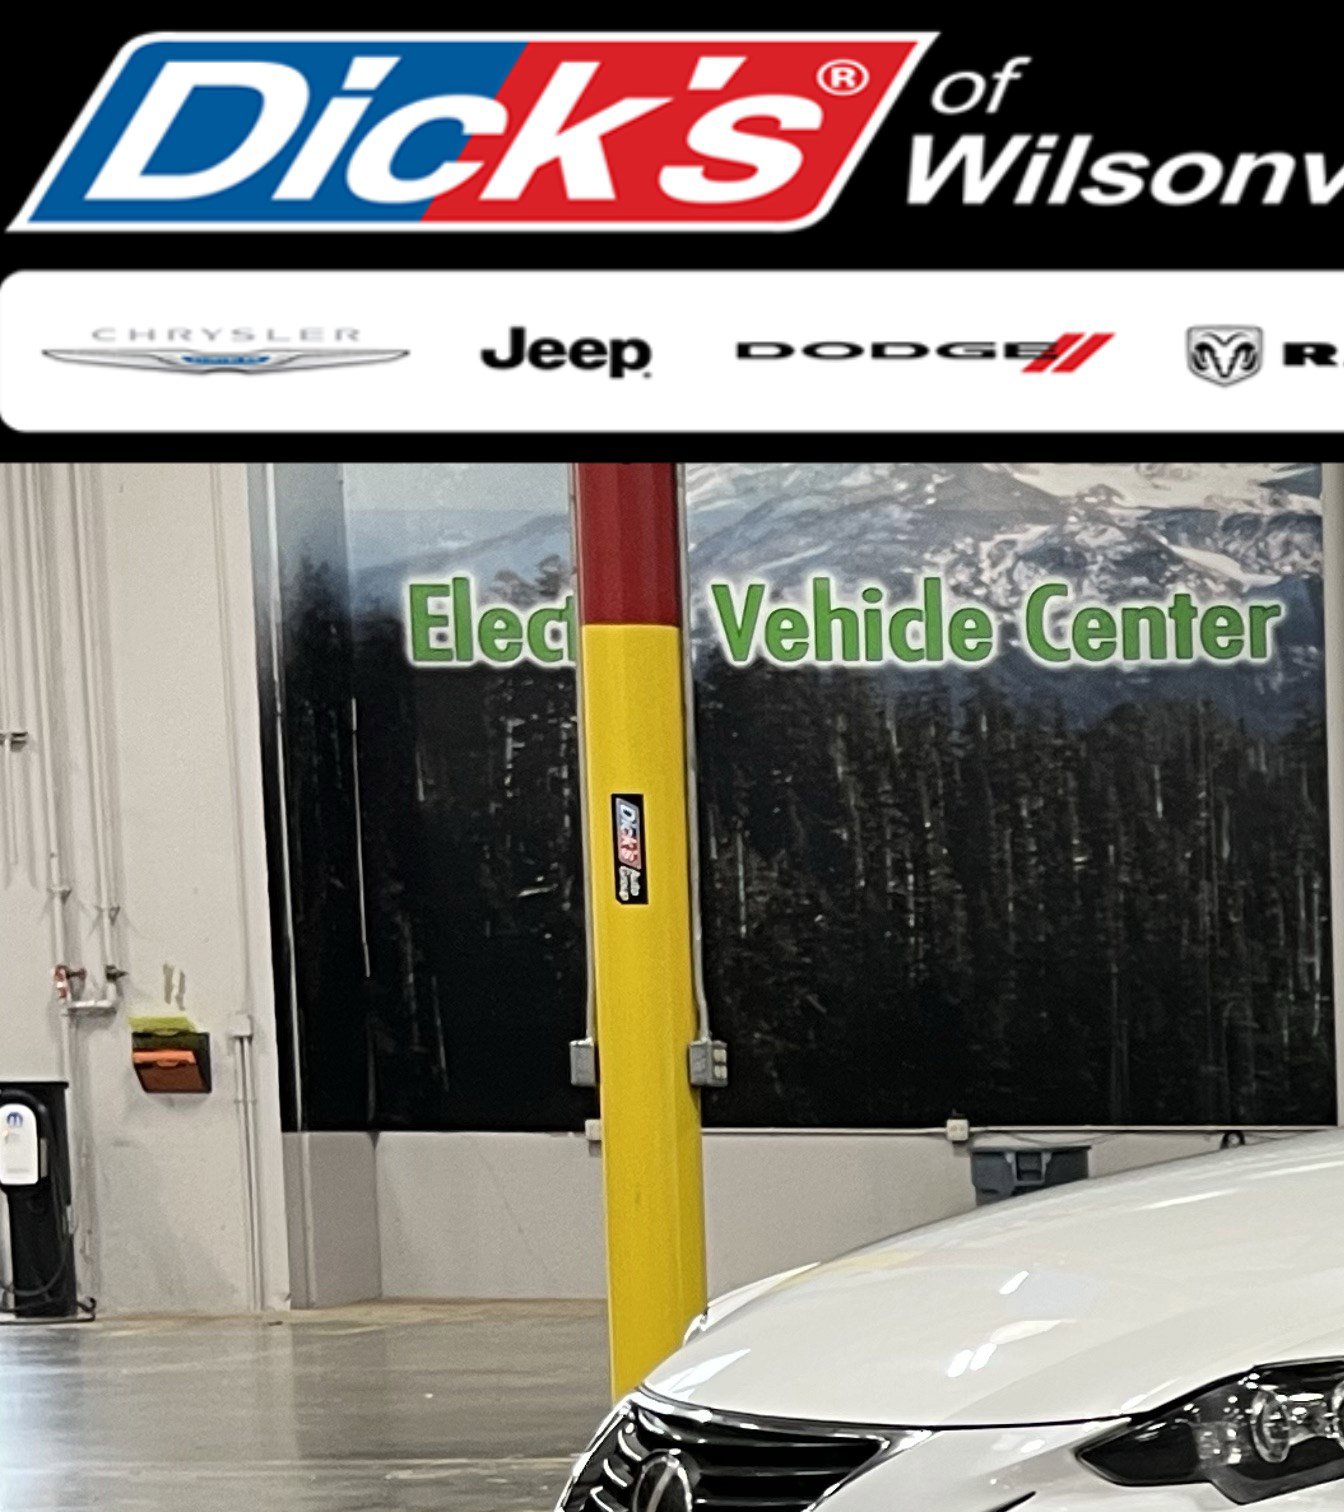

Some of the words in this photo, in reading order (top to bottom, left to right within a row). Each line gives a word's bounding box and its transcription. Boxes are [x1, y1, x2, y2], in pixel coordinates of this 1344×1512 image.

[410, 577, 576, 661] Elect
[711, 577, 994, 661] Vehicle
[1026, 584, 1281, 660] Center
